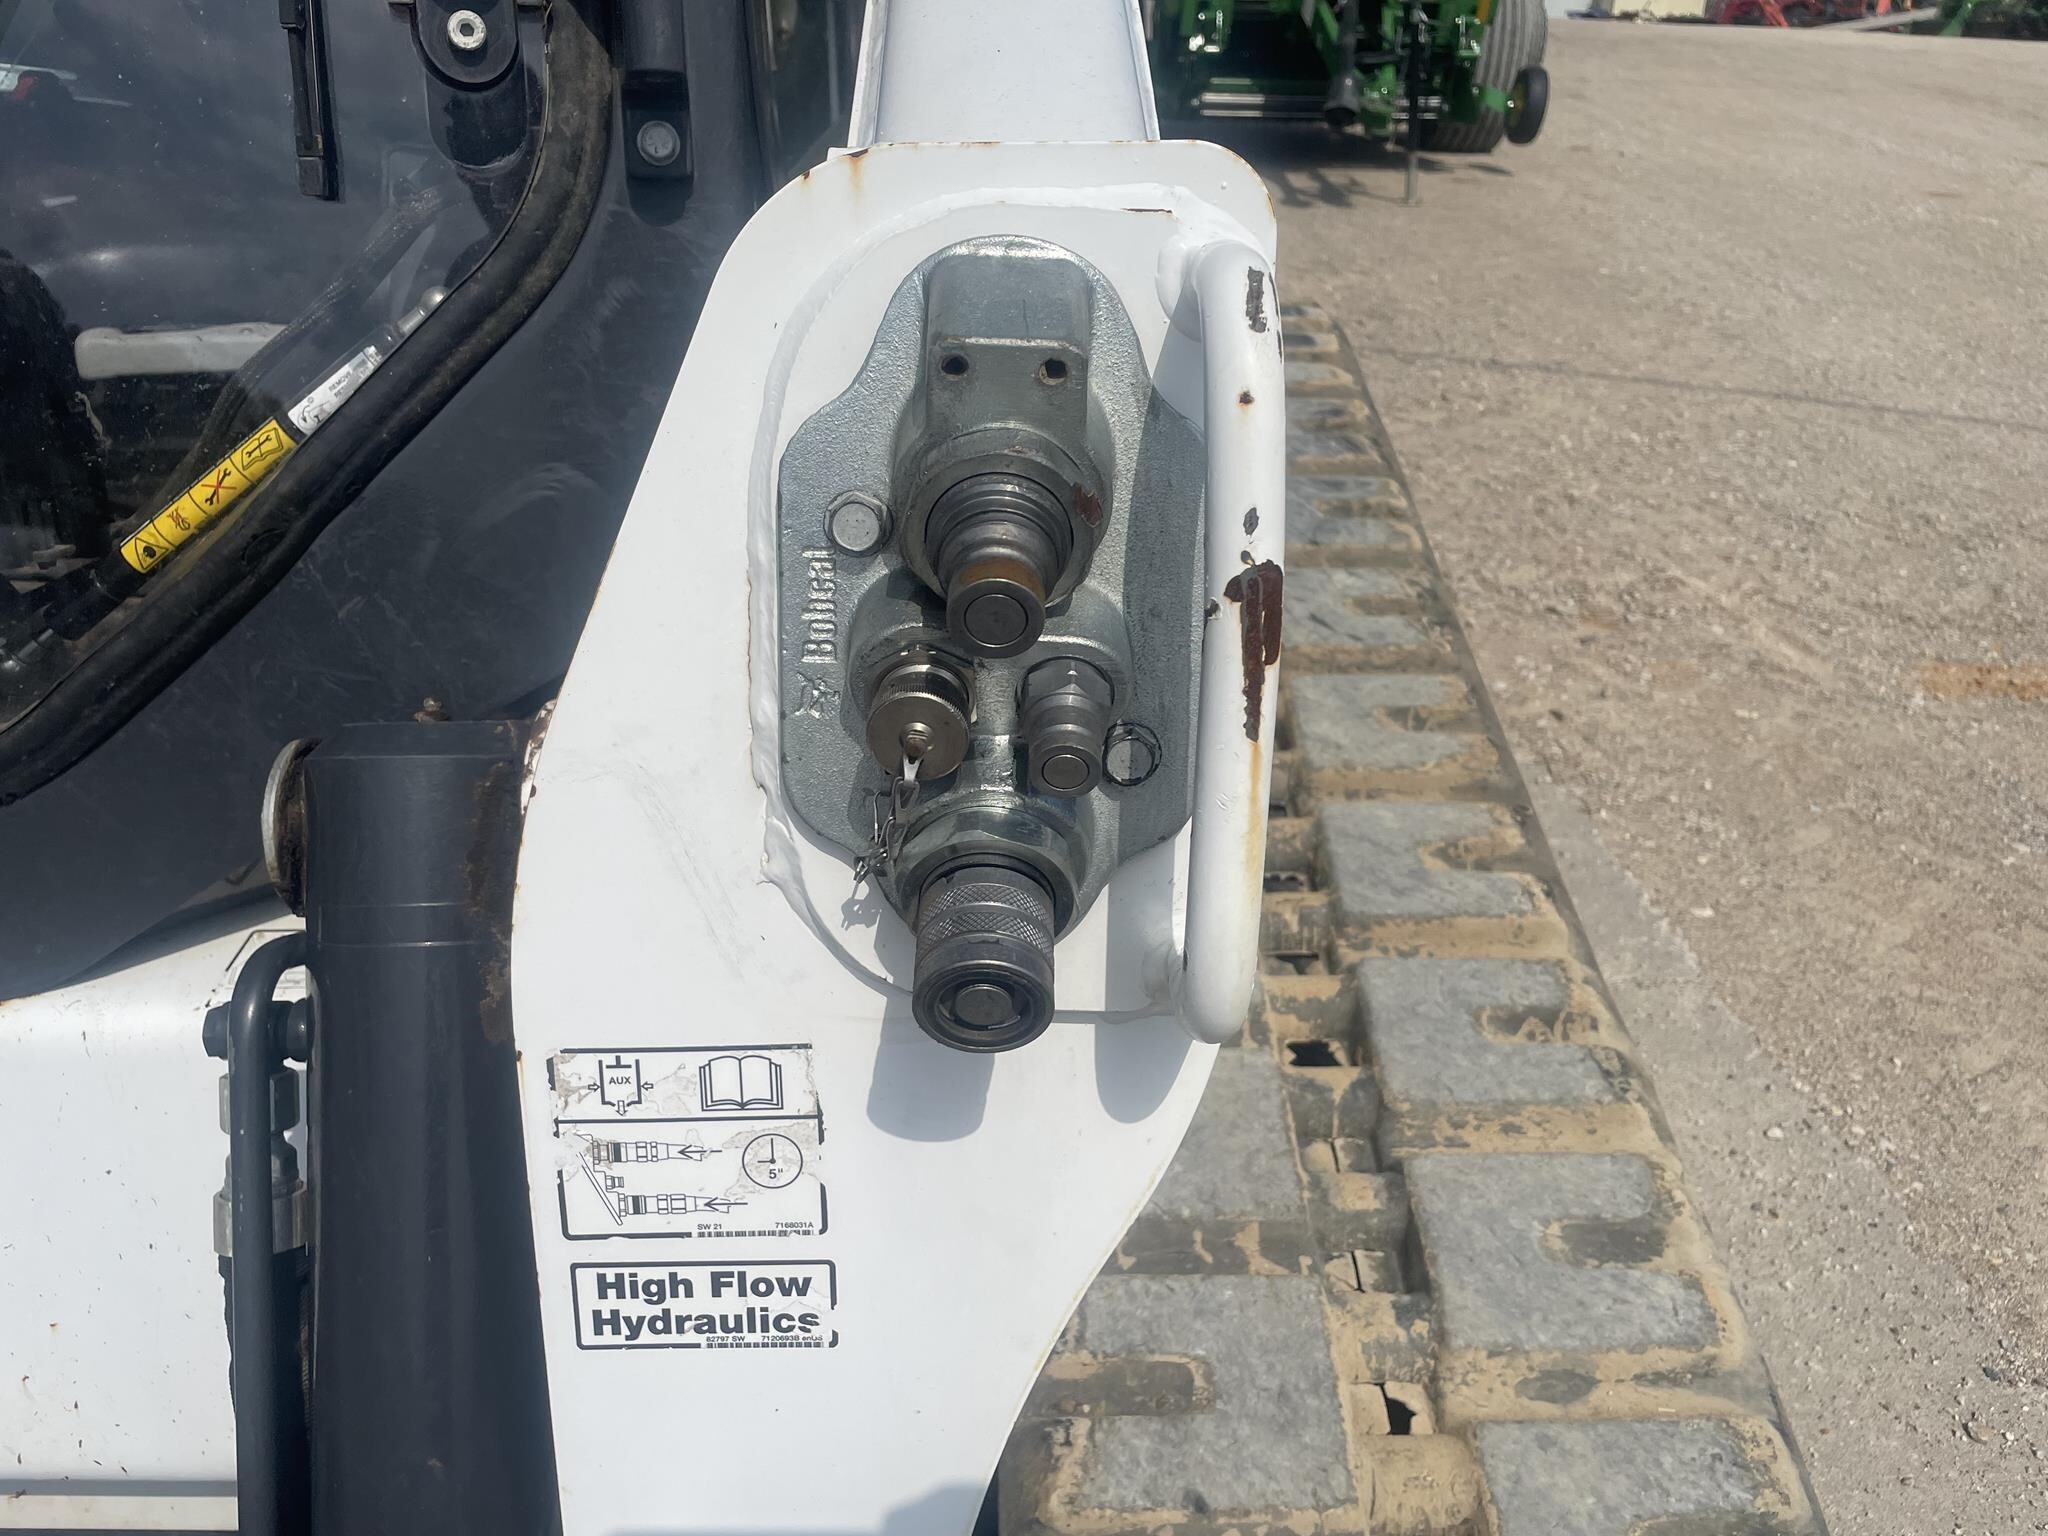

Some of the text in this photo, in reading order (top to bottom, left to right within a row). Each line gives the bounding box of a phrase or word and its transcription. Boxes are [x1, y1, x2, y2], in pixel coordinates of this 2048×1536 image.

[609, 1076, 632, 1085] AUX
[775, 1221, 814, 1229] 7168031A
[596, 1271, 812, 1305] High Flow
[592, 1307, 820, 1341] Hydraulics
